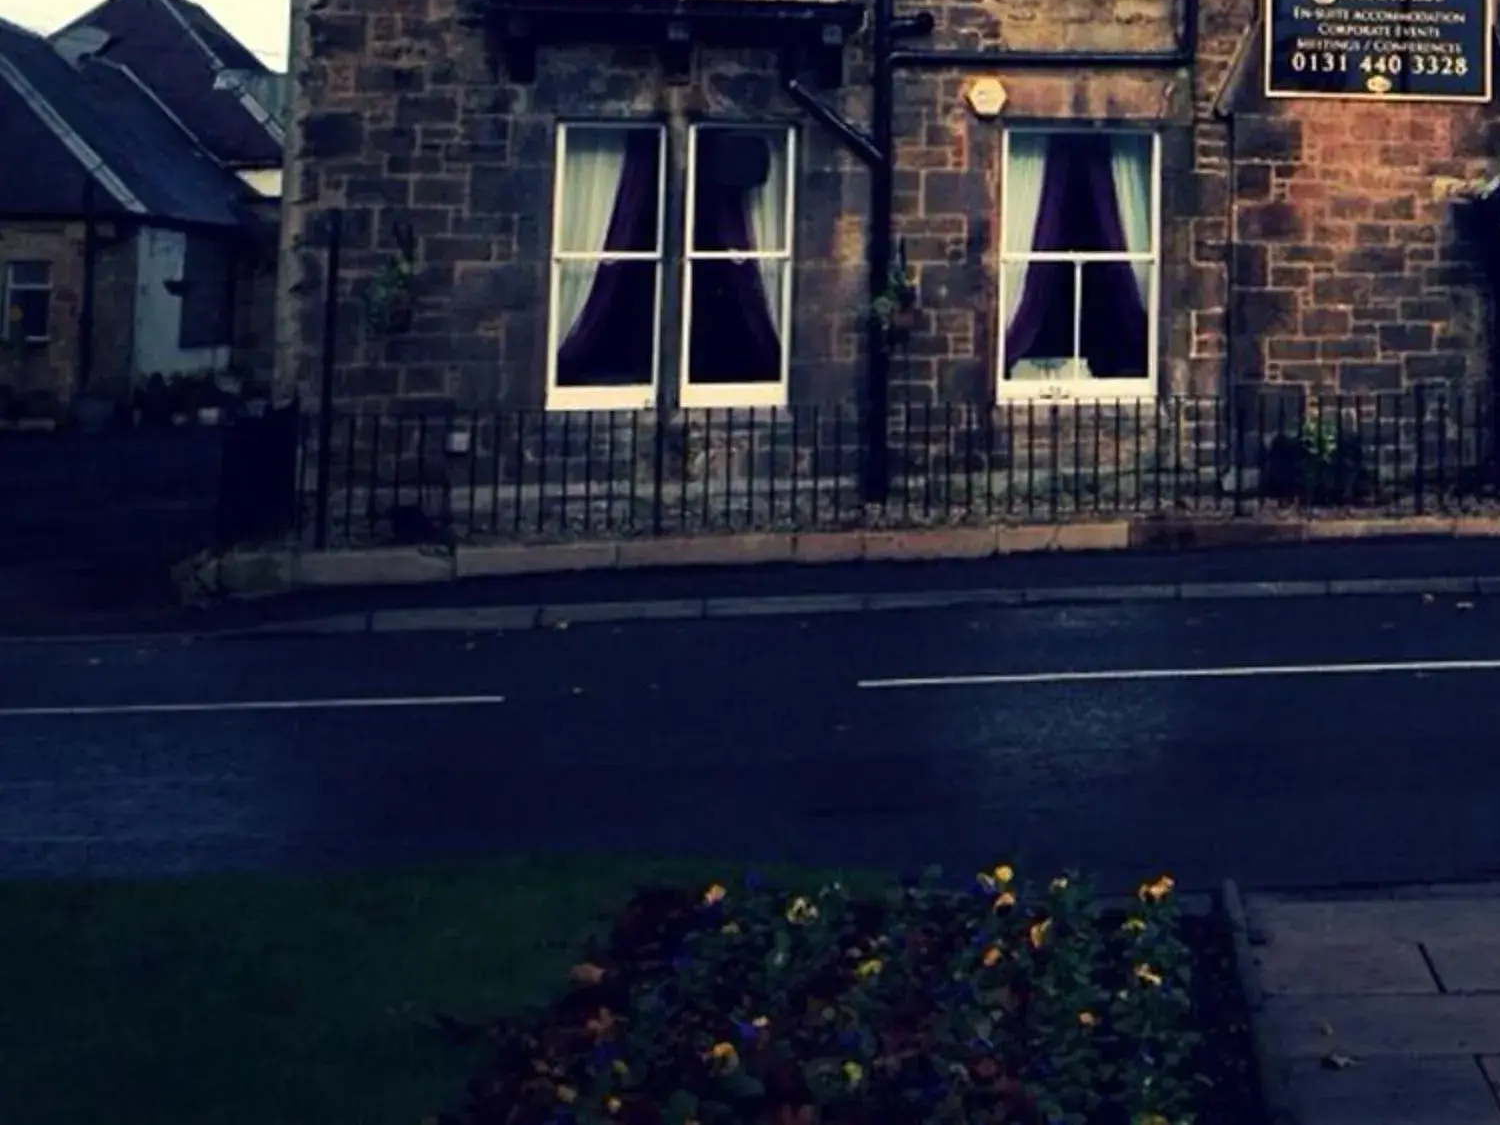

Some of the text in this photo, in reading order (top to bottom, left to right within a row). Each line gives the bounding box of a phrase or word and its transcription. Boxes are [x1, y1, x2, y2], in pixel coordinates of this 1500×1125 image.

[1292, 52, 1468, 76] 0131 440 3328
